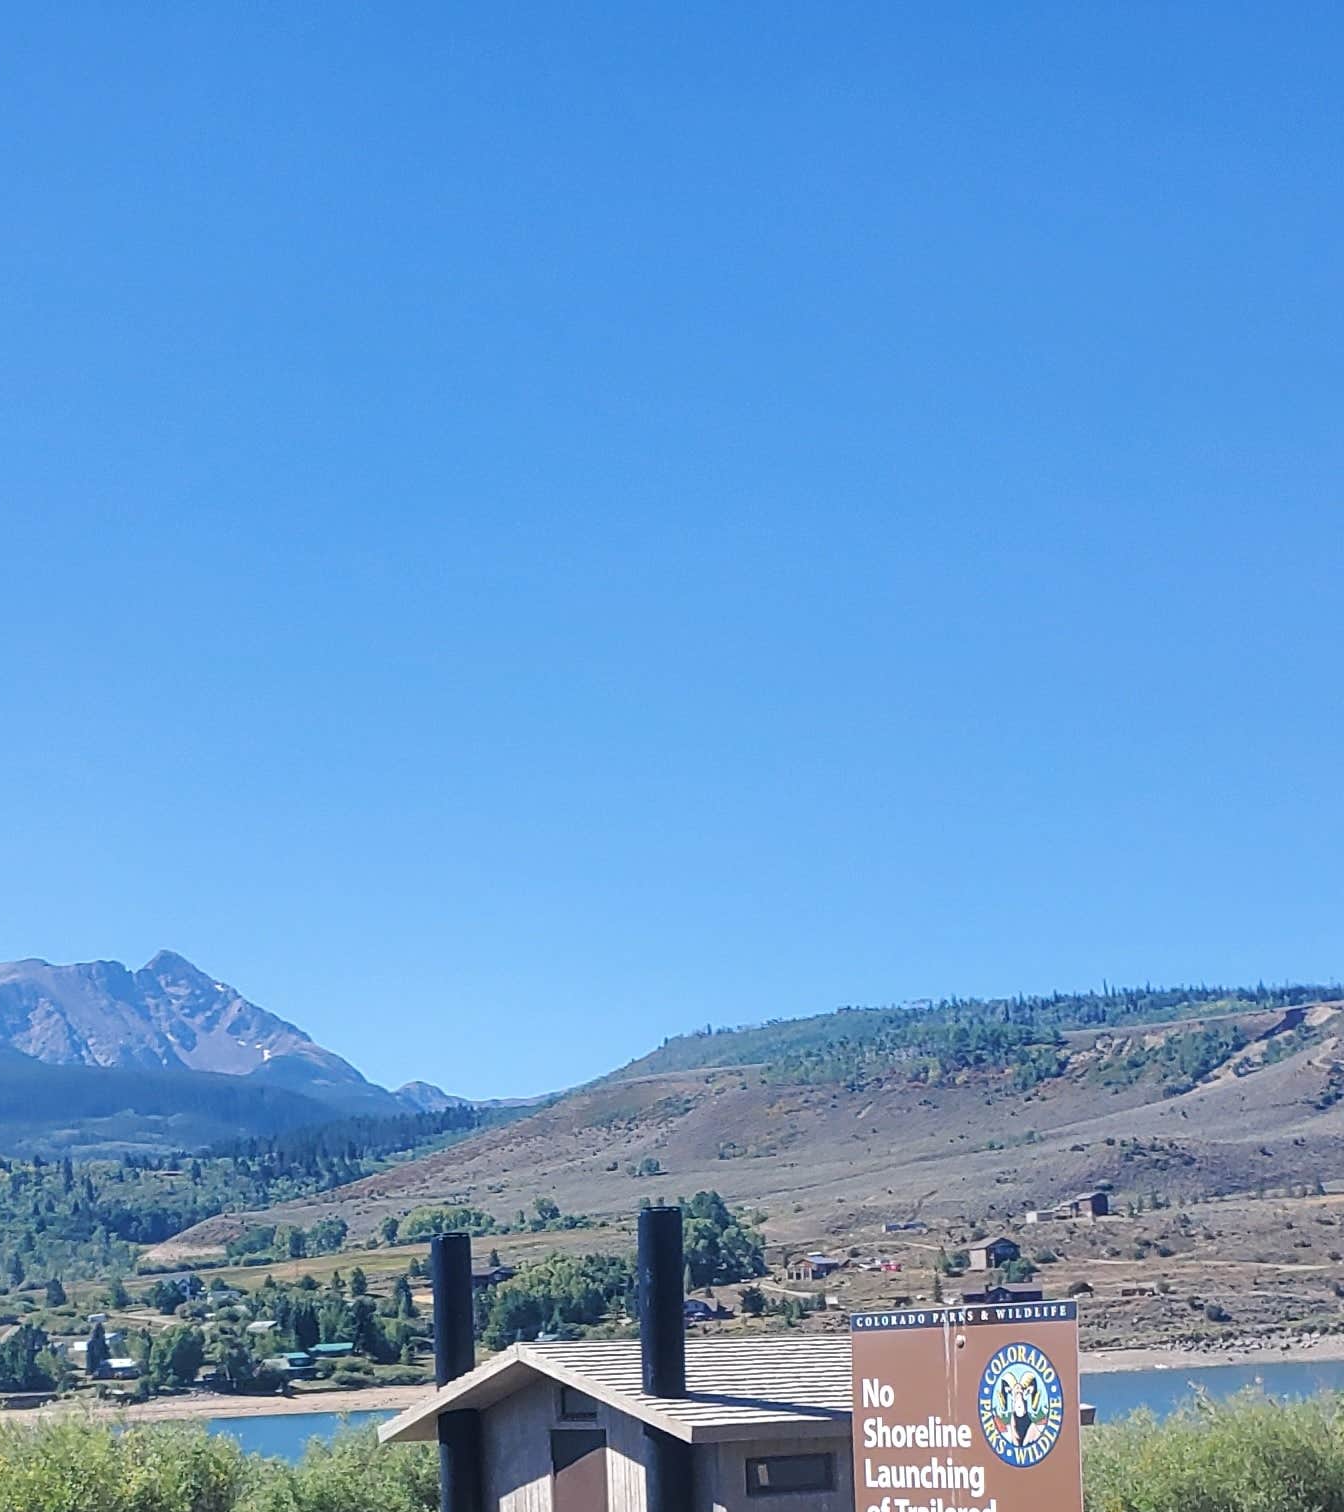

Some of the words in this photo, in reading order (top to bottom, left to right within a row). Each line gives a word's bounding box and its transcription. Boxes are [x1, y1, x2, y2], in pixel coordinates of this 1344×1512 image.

[856, 1314, 925, 1327] COLORADO
[933, 1310, 973, 1323] PARKS
[981, 1310, 989, 1321] &
[996, 1305, 1067, 1320] WILDLIFE
[985, 1345, 1055, 1385] COLORADO
[862, 1378, 895, 1408] No
[863, 1416, 972, 1448] Shoreline
[980, 1399, 1007, 1454] PARKS
[1014, 1397, 1062, 1465] WILDLIFE
[865, 1457, 985, 1498] Launching
